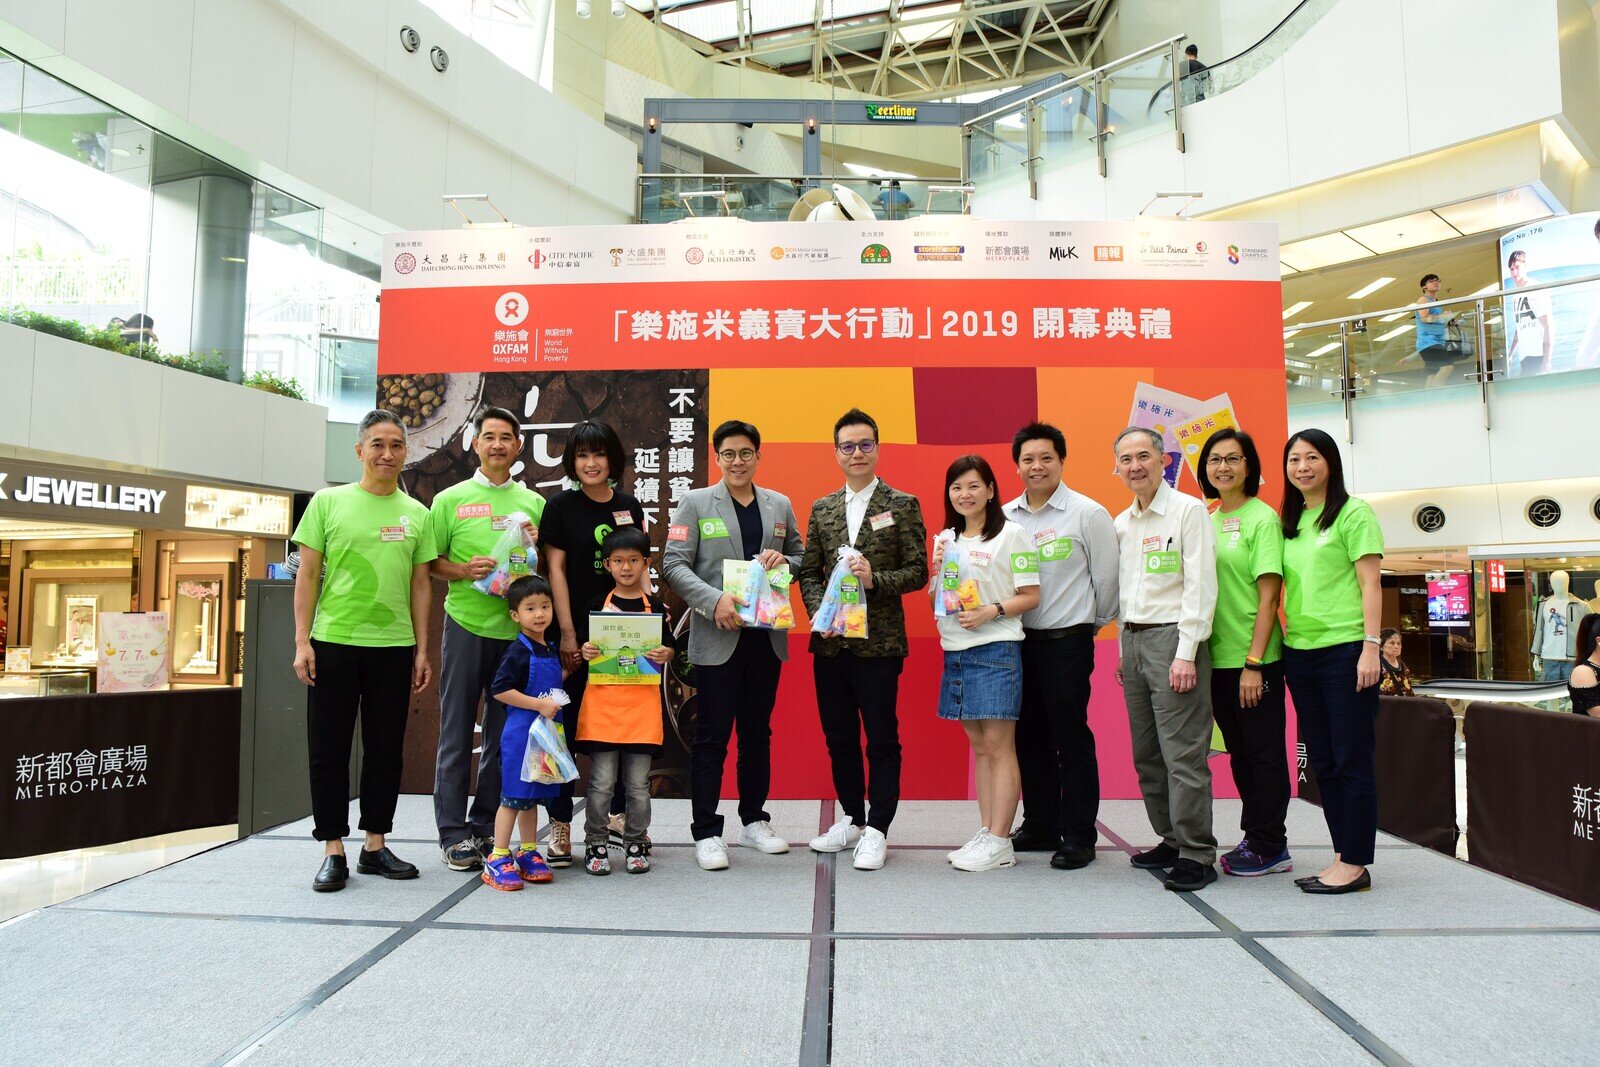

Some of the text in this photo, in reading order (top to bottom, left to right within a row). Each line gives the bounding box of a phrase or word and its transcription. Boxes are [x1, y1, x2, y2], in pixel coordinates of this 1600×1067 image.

[865, 103, 917, 117] Beerliner
[1502, 236, 1514, 247] Shop
[569, 251, 594, 259] PACIFIC
[628, 247, 666, 257] 大盛集團
[708, 248, 756, 257] 大昌行物流
[985, 245, 1029, 256] 新都會廣場
[1149, 245, 1164, 254] Petit
[422, 252, 506, 265] 大昌行集團
[549, 260, 580, 268] 中信泰富
[614, 306, 1172, 342] 「樂施米義賣大行動」 2019 開幕典禮
[494, 329, 529, 342] 樂施會
[544, 328, 574, 337] 無窮世界
[493, 343, 529, 355] OXFAM
[493, 355, 527, 364] Hong Kong
[544, 355, 569, 363] Poverty
[1138, 399, 1175, 418] 樂施米
[1179, 418, 1215, 440] 樂施米
[14, 475, 167, 514] JEWELLERY
[15, 744, 148, 784] 新都會廣場
